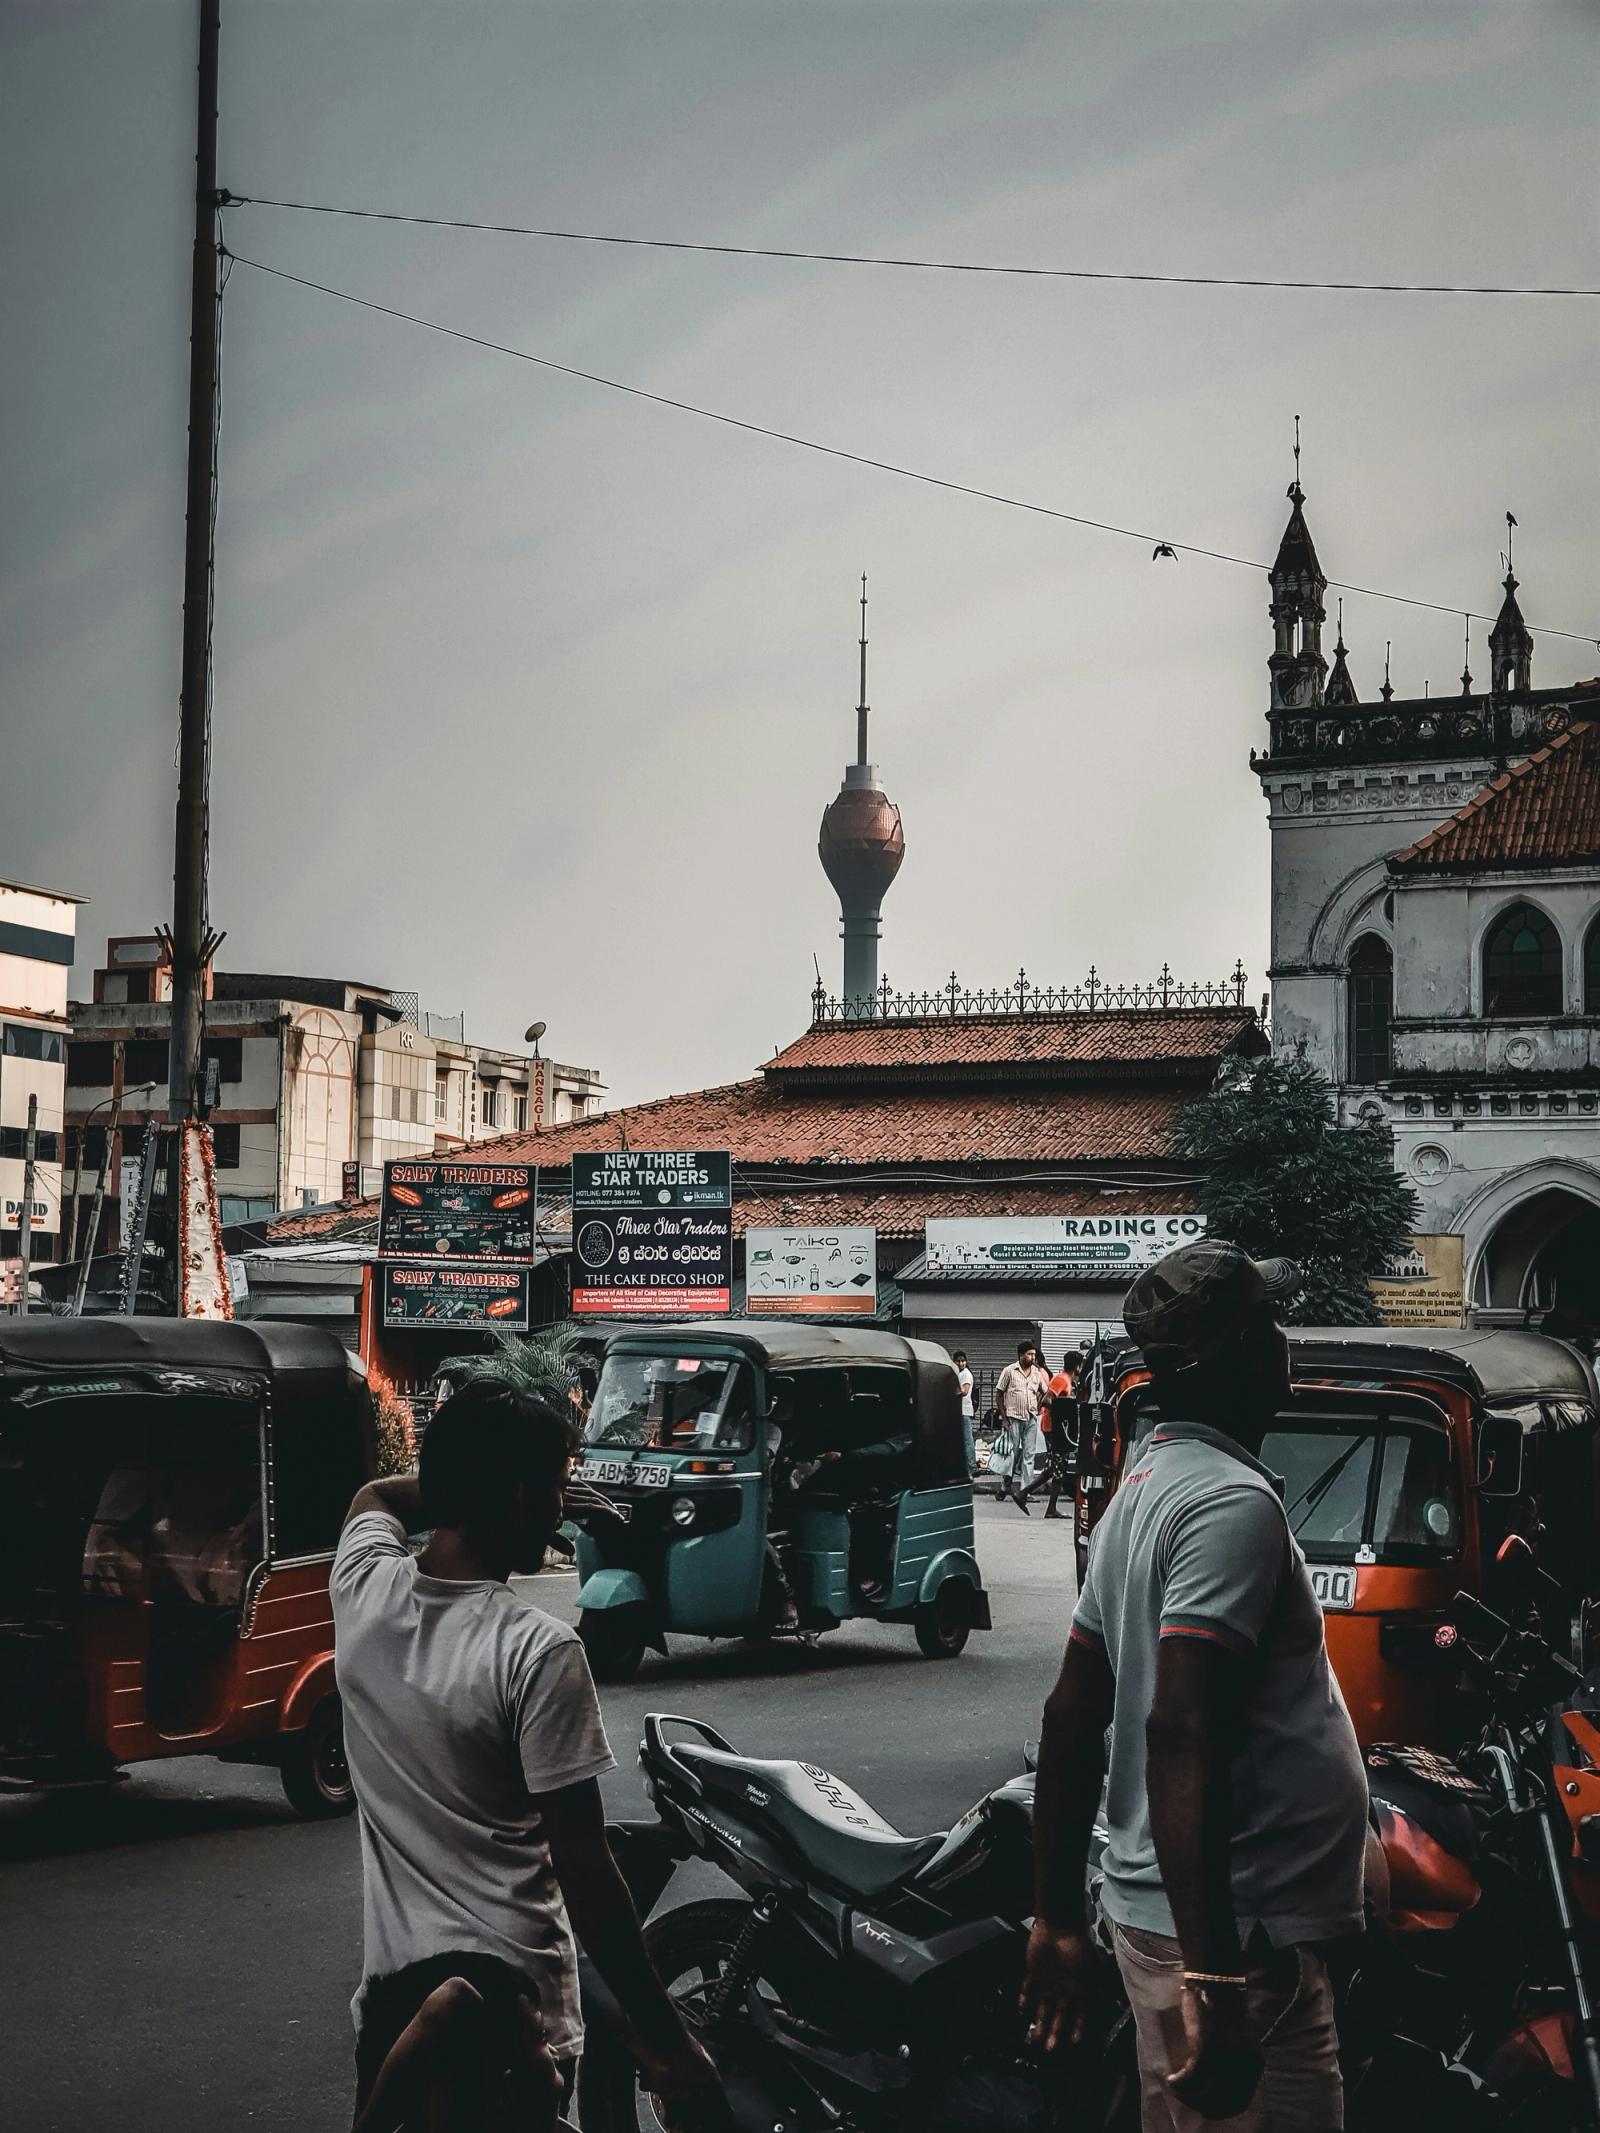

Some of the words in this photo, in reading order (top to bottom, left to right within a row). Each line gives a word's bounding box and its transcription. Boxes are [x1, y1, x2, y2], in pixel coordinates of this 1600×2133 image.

[400, 1031, 414, 1049] KR
[604, 1154, 641, 1169] NEW
[644, 1153, 696, 1168] THREE
[391, 1166, 437, 1182] SALY
[441, 1166, 528, 1186] TRADERS
[591, 1171, 631, 1186] STAR
[635, 1170, 709, 1185] TRADERS
[693, 1191, 725, 1200] ikman.lk
[6, 1201, 49, 1217] DAID
[616, 1216, 651, 1236] Three
[653, 1216, 682, 1236] Star
[681, 1217, 728, 1236] Traders
[1061, 1219, 1156, 1236] RADING
[393, 1271, 434, 1285] SALY
[439, 1272, 520, 1288] TRADERS
[585, 1274, 612, 1285] THE
[614, 1274, 647, 1285] CAKE
[650, 1274, 686, 1285] DECO
[690, 1273, 725, 1285] SHOP
[688, 1289, 719, 1297] Equipments
[1405, 1309, 1425, 1317] HALL
[1427, 1309, 1461, 1317] BUILDING
